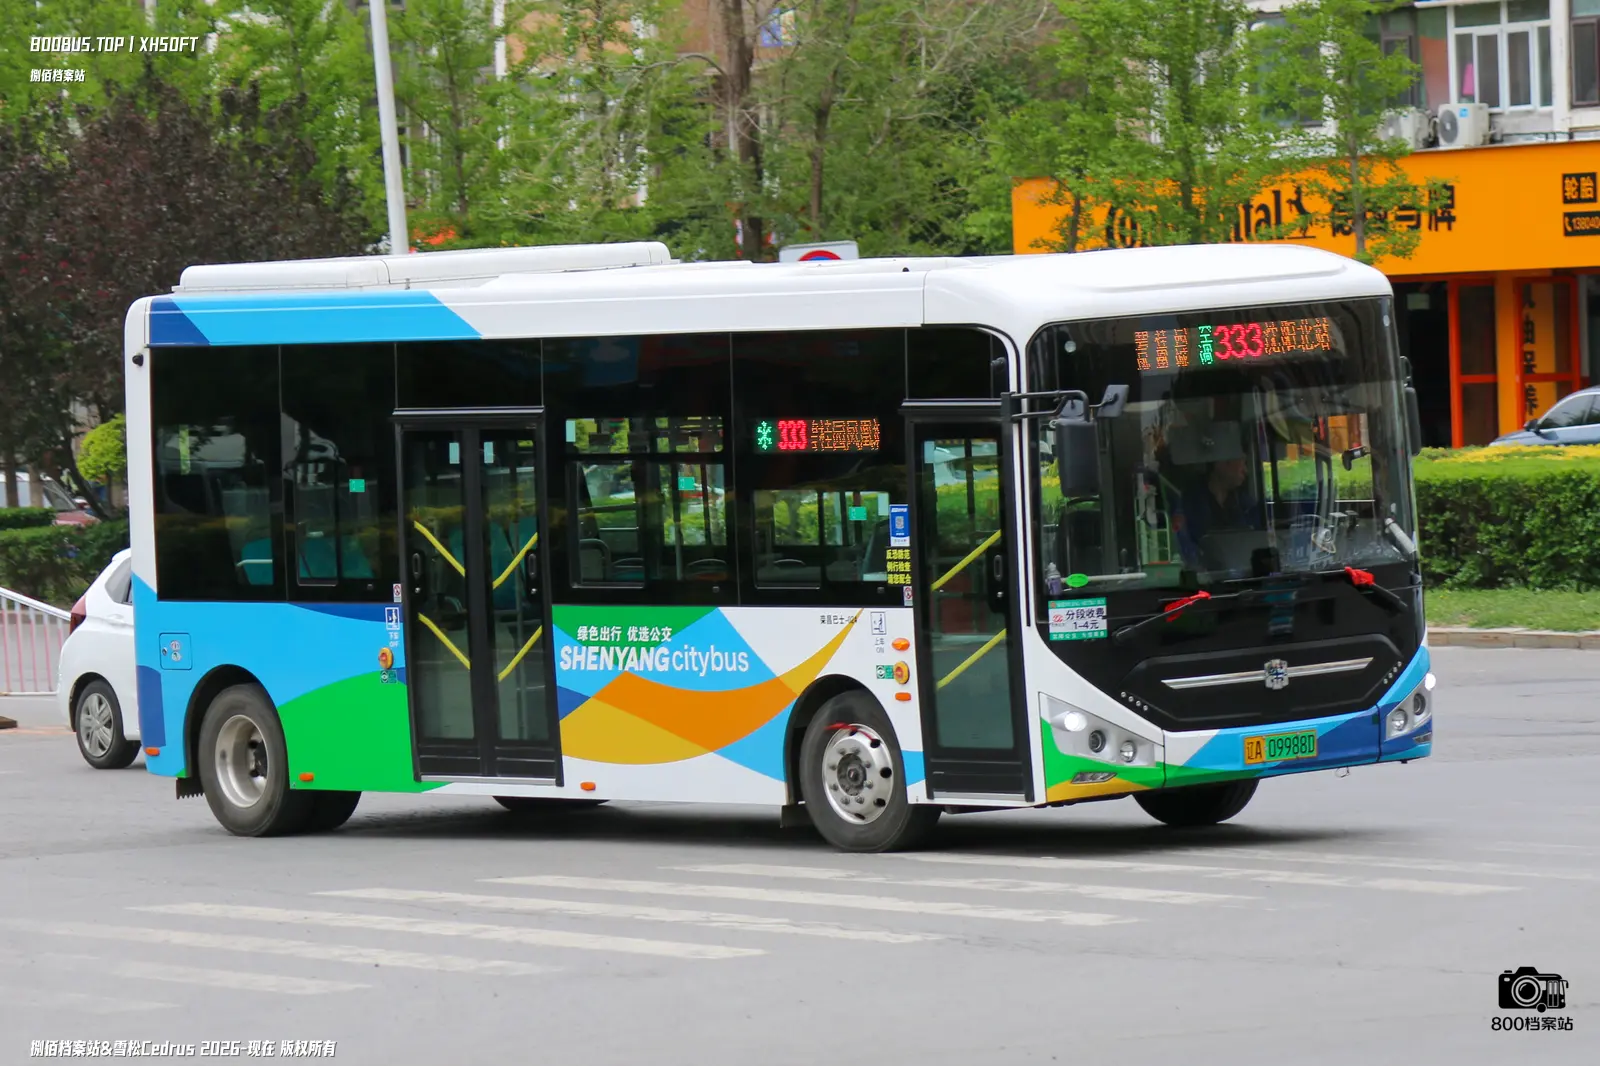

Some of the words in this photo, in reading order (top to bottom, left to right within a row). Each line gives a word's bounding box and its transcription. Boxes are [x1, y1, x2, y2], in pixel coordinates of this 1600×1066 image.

[1564, 176, 1594, 200] 轮胎
[1199, 325, 1214, 365] 空调
[1214, 323, 1264, 359] 333
[1263, 317, 1331, 354] 沈阳北站
[778, 420, 807, 450] 333
[1066, 607, 1105, 620] 分段收费
[1073, 620, 1099, 630] 1-4元
[577, 625, 622, 641] 绿色出行
[627, 626, 672, 642] 优选公交
[560, 645, 670, 671] SHENYANG
[671, 644, 749, 676] citybus
[1268, 734, 1315, 757] 09988D
